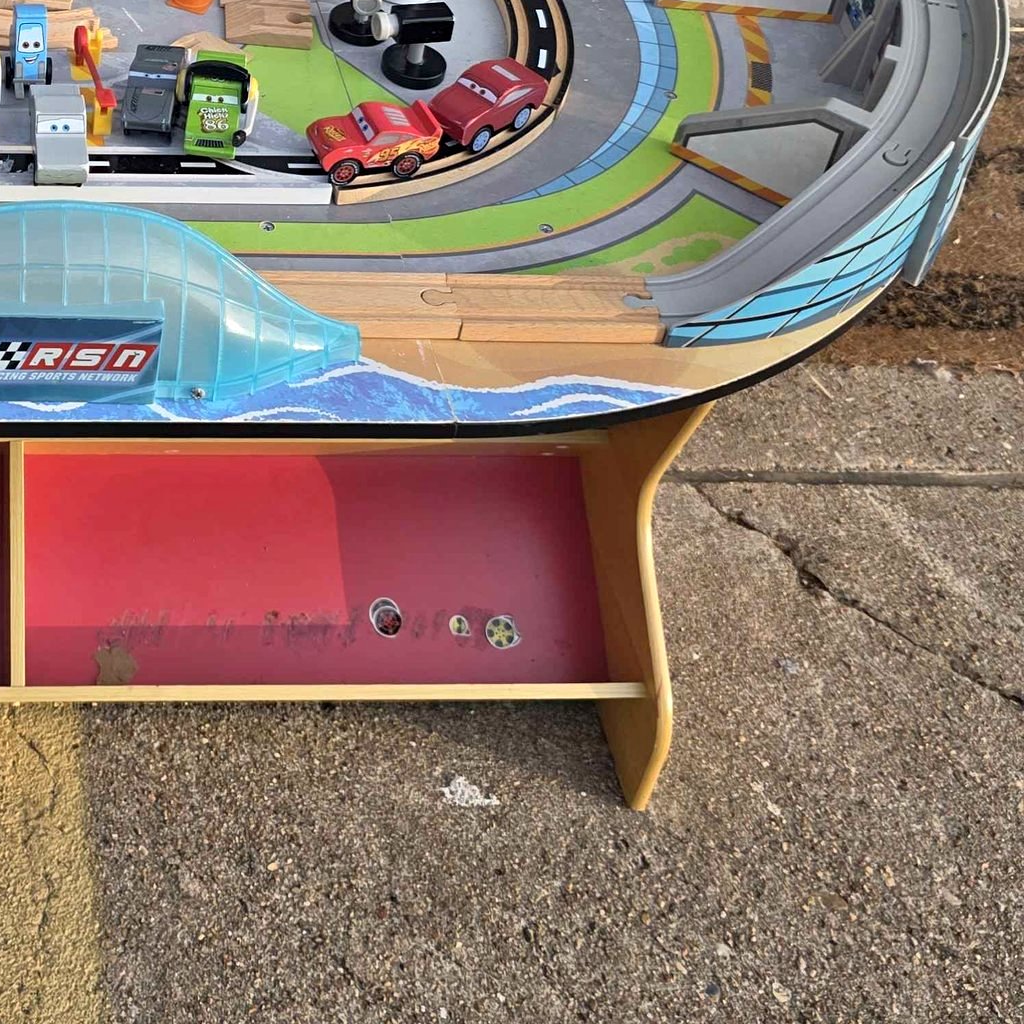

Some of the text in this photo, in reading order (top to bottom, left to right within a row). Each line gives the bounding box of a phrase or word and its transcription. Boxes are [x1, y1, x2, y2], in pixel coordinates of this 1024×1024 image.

[204, 119, 229, 131] 86
[29, 347, 147, 368] RSN
[29, 372, 75, 381] SPORTS
[78, 373, 138, 382] NETWORK
